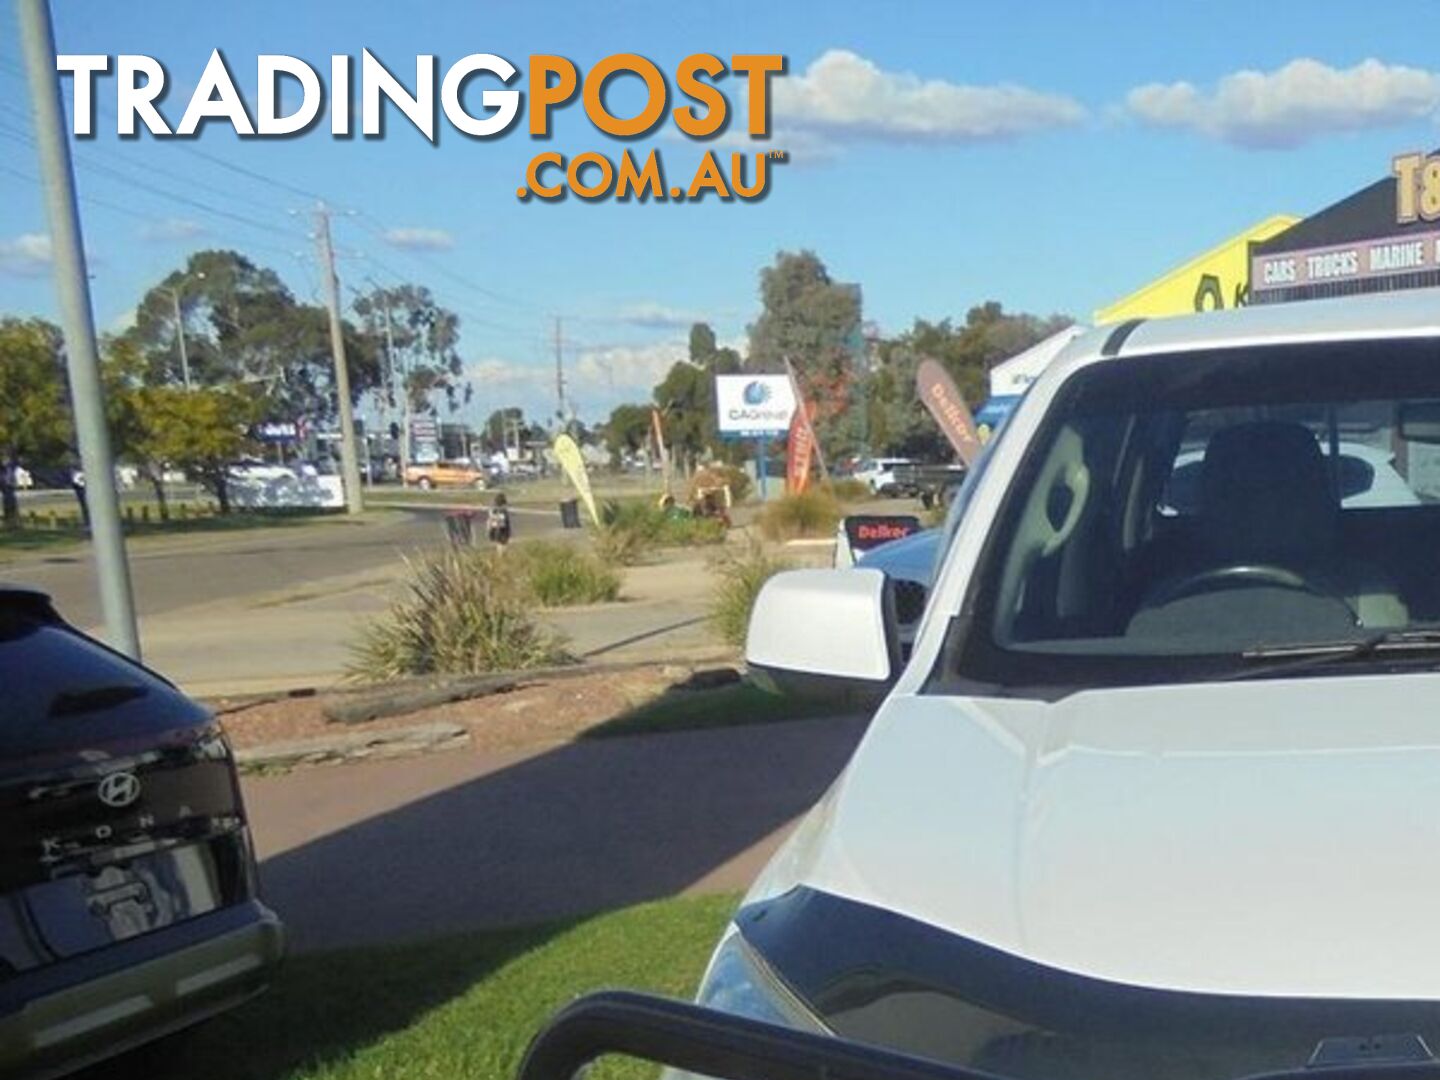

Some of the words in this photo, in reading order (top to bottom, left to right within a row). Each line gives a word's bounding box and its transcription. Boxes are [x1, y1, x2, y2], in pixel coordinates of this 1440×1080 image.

[1264, 258, 1296, 284] CARS
[1307, 250, 1358, 279] TRUCKS
[1370, 242, 1424, 271] MARINE
